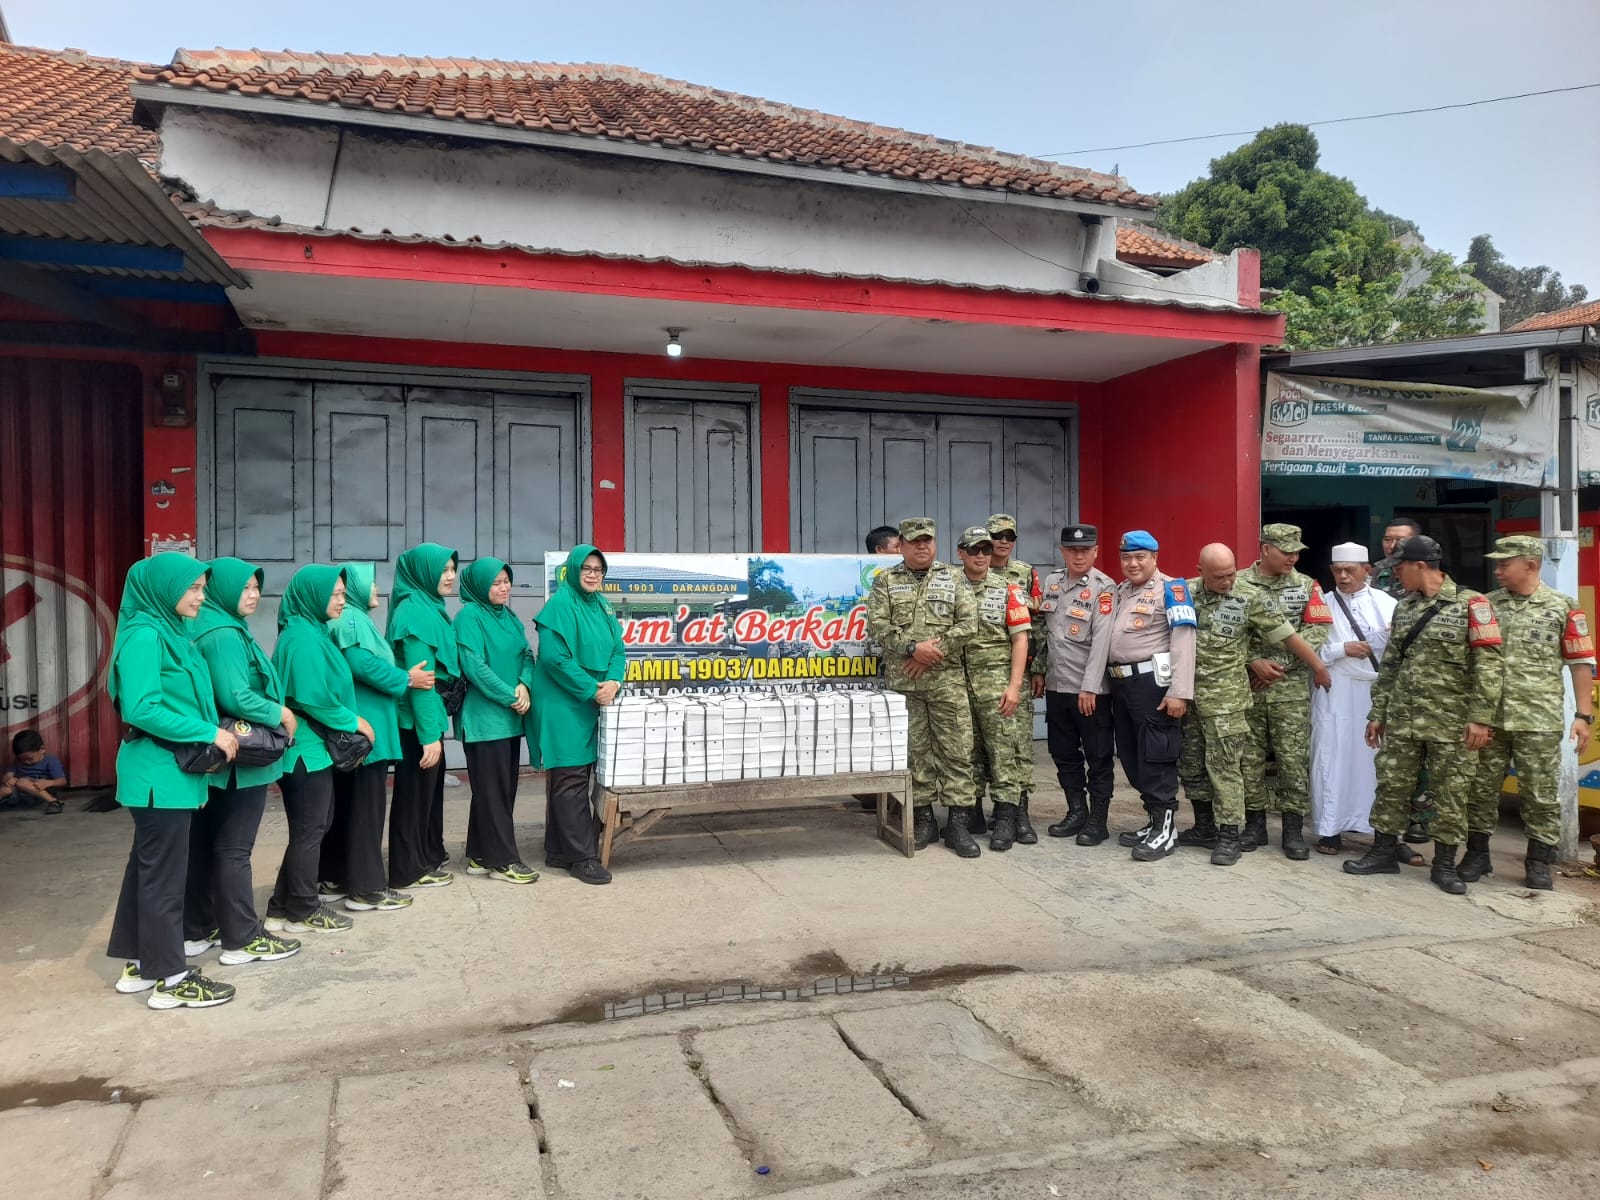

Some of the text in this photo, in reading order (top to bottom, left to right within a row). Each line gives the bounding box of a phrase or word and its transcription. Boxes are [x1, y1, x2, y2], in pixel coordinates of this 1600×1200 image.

[1314, 402, 1345, 412] FRESH
[1368, 433, 1393, 442] TANPA
[1281, 444, 1305, 457] dan
[1306, 445, 1399, 461] Menyegarkan
[1263, 461, 1314, 475] Pertigaan
[1314, 463, 1347, 475] Sawit
[628, 583, 654, 592] 1903
[672, 583, 738, 593] DARANGDAN
[1072, 599, 1092, 609] POLRI
[735, 606, 868, 650] Berkah
[685, 656, 878, 681] 1903/DARANGDAN
